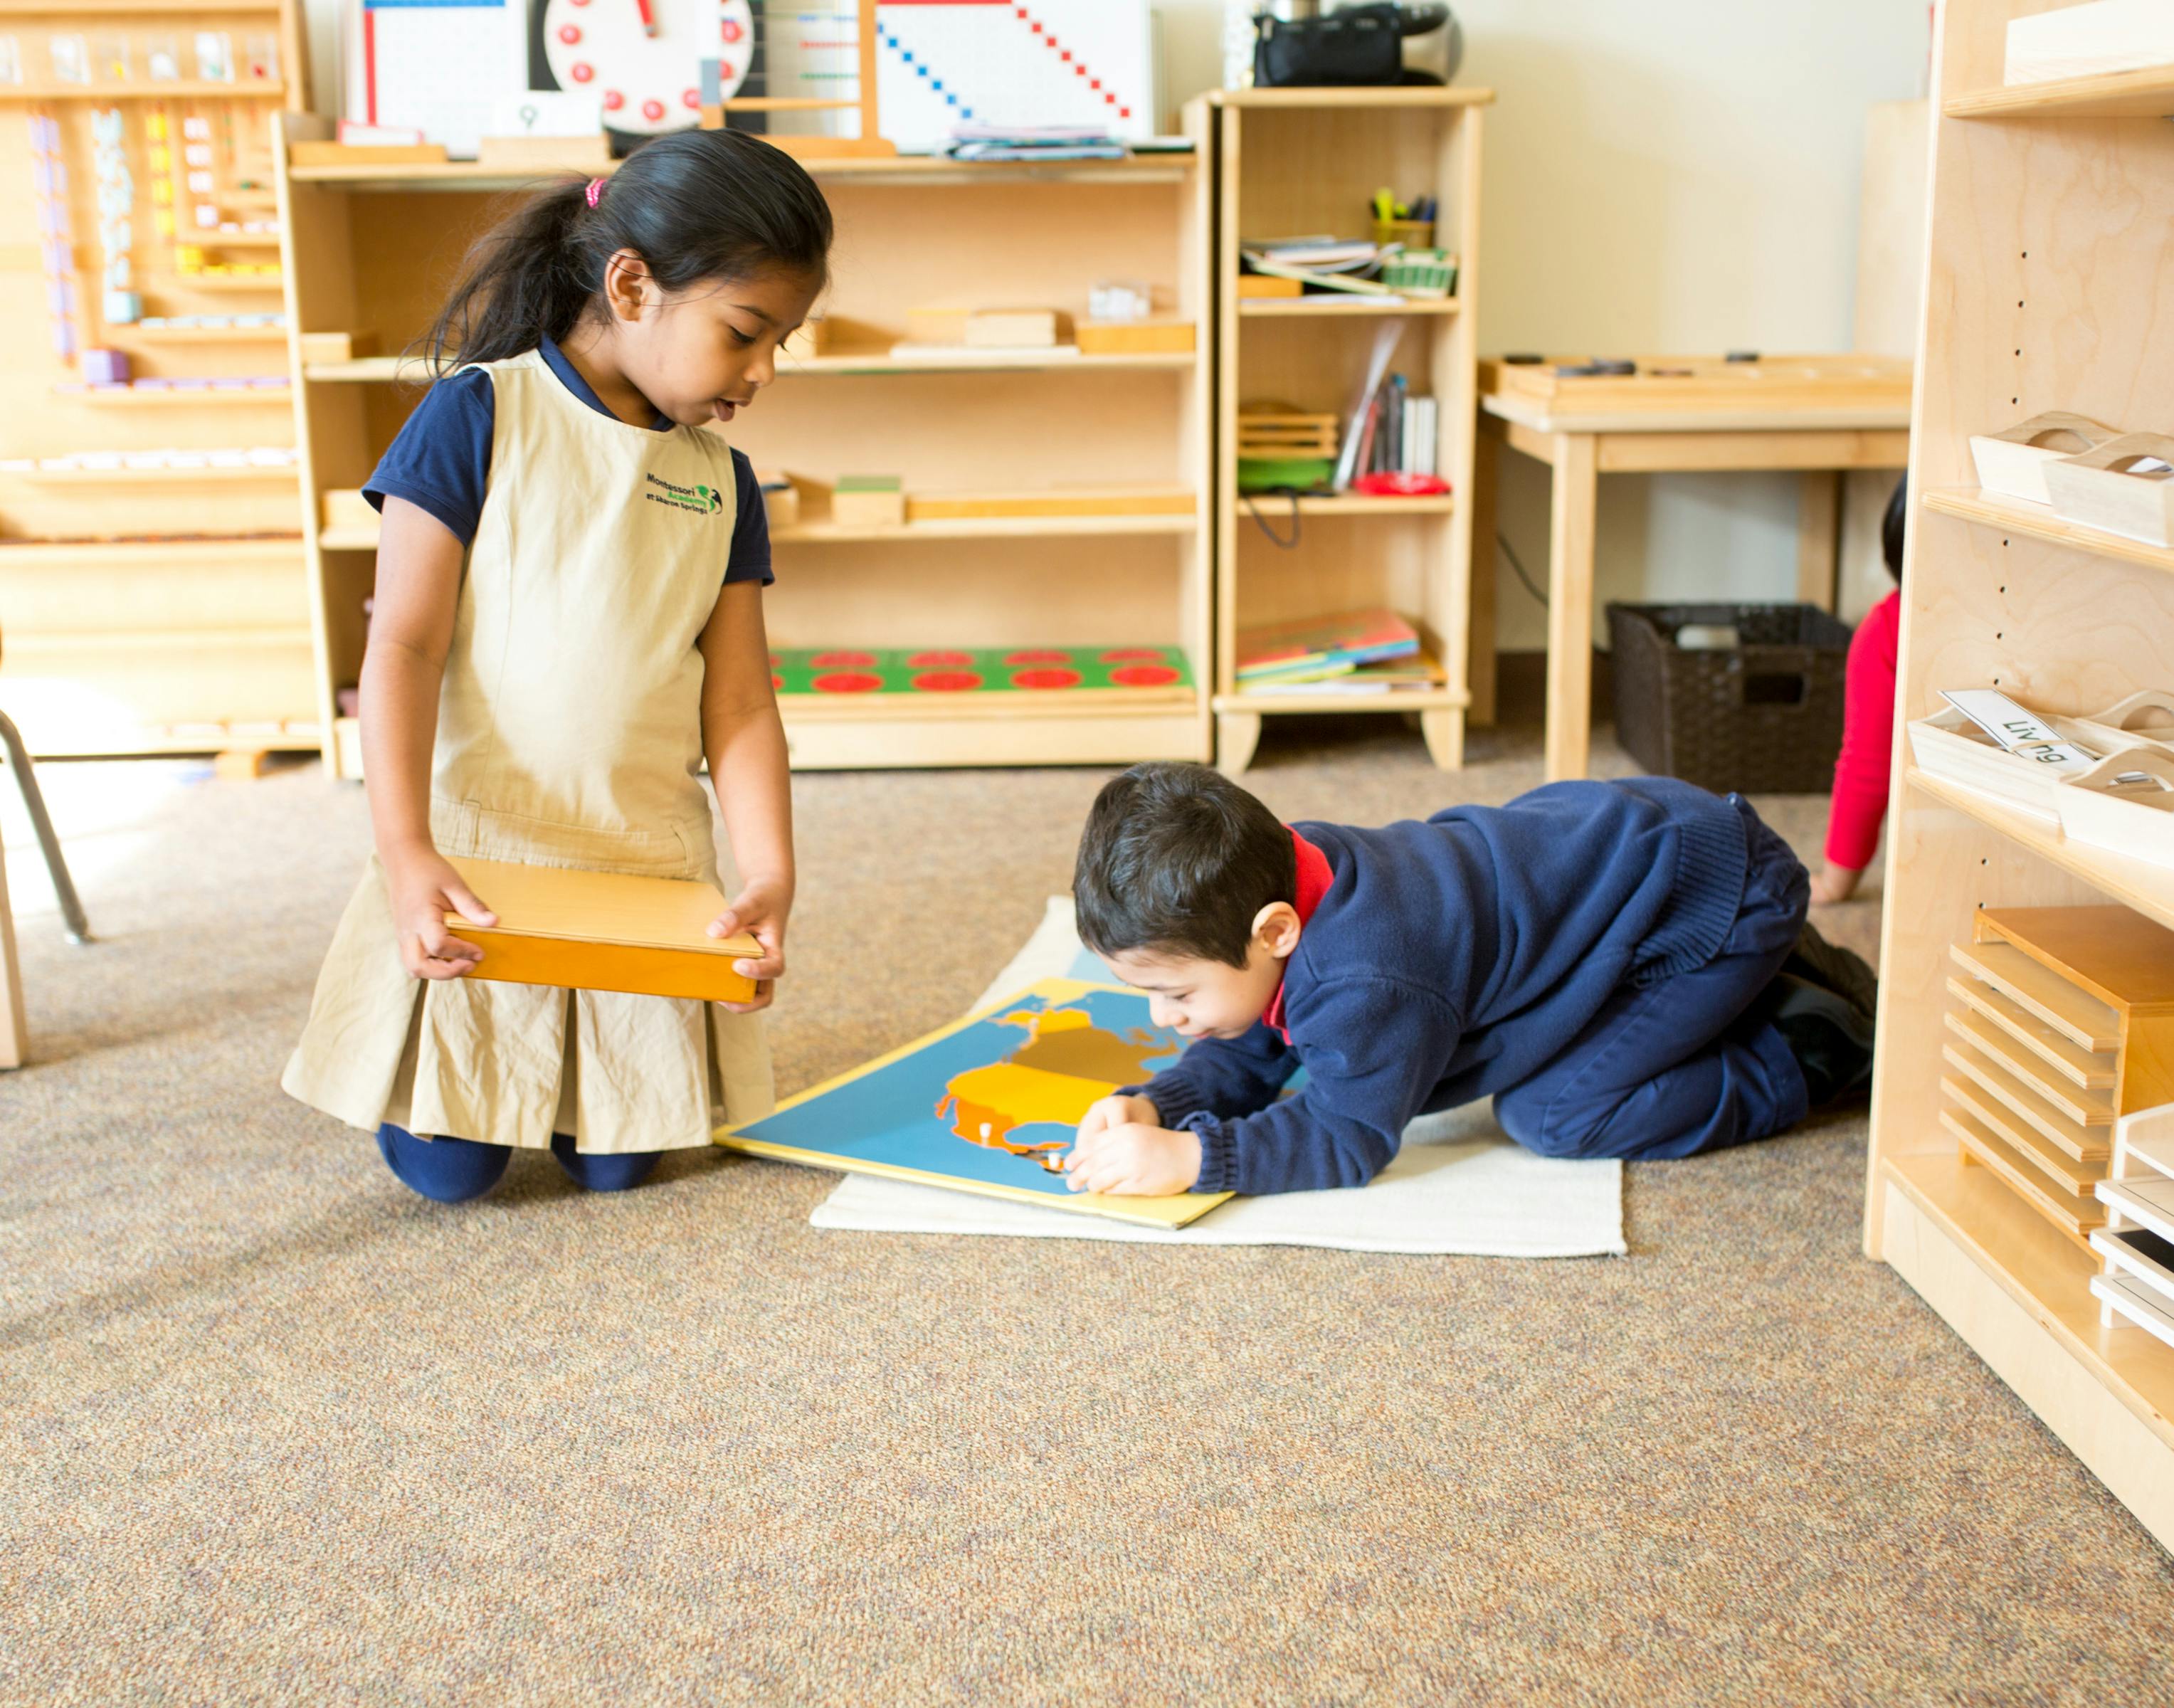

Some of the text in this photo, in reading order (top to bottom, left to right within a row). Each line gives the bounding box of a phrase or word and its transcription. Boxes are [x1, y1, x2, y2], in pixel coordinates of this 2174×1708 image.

[646, 473, 695, 497] Montessori
[655, 495, 679, 507] Sharon
[680, 502, 708, 515] Springs
[2002, 721, 2069, 763] Livng
